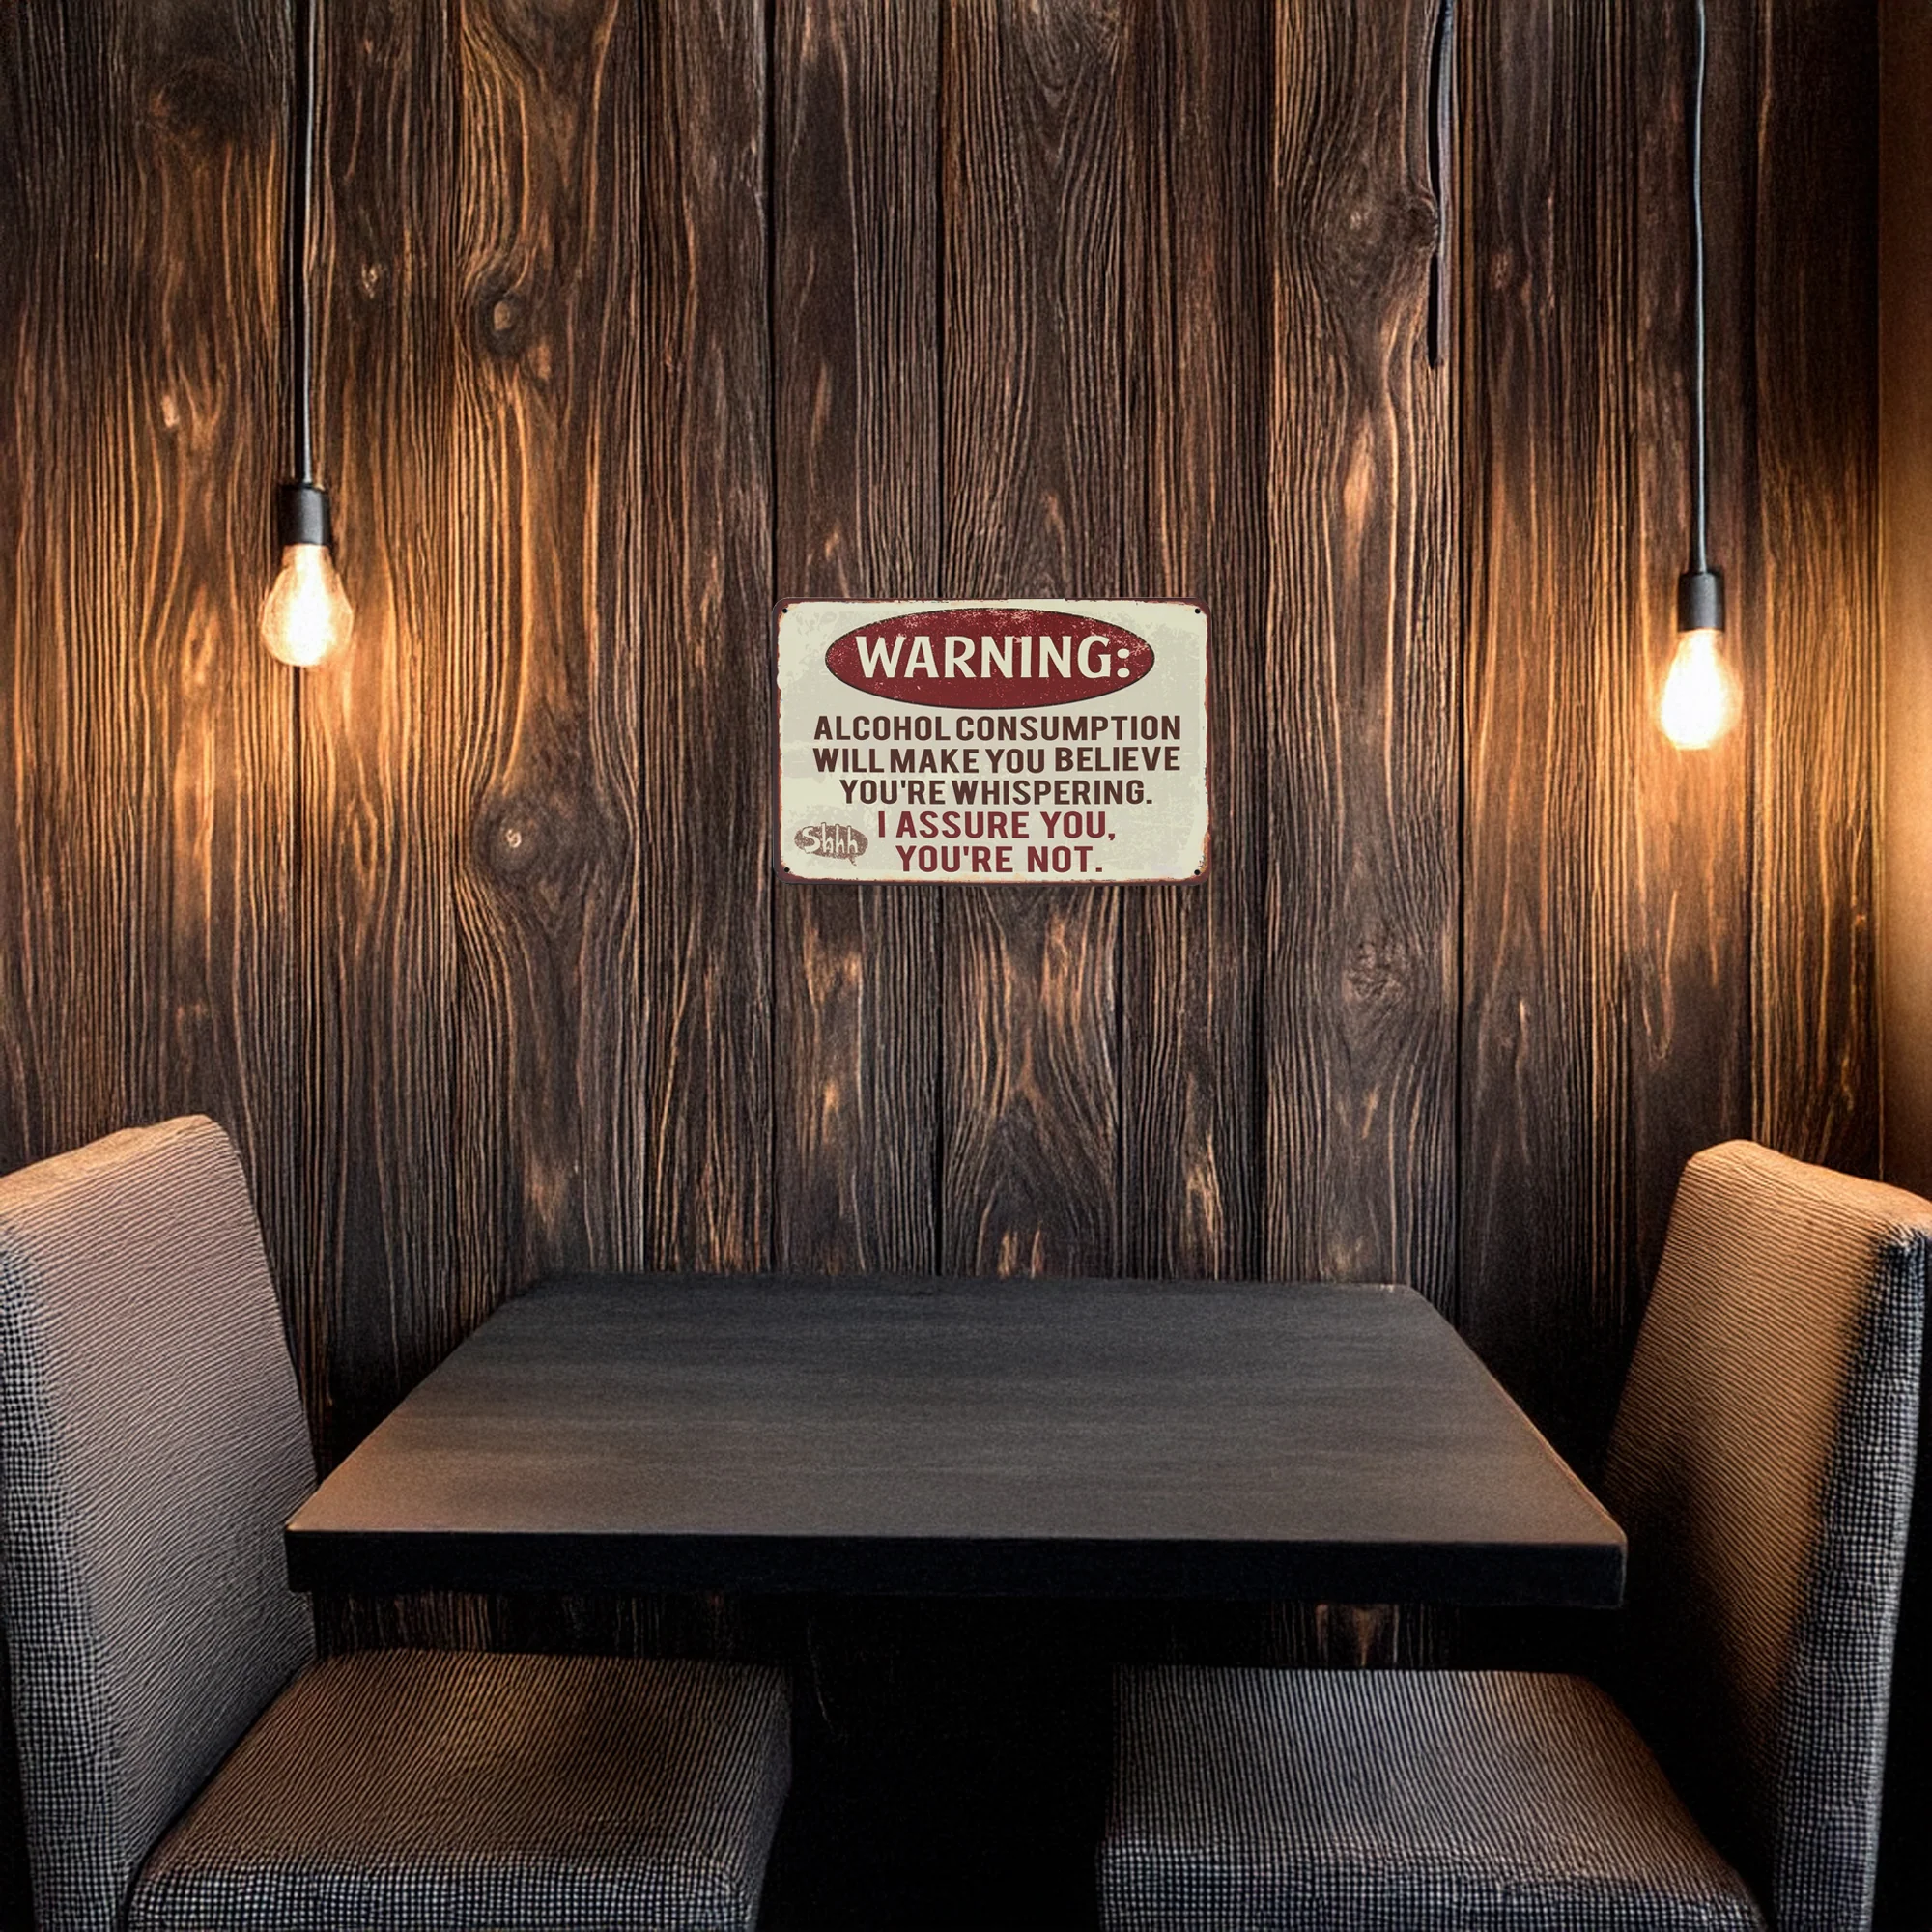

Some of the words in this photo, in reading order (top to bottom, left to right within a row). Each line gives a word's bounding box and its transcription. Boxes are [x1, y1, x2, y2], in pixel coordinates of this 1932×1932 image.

[855, 635, 1131, 678] WARNING:
[813, 715, 952, 741] ALCOHOL
[955, 715, 1181, 741] CONSUMPTION
[812, 748, 885, 773] WILL
[890, 748, 980, 773] MAKE
[985, 748, 1045, 773] YOU
[1054, 746, 1181, 772] BELIEVE
[838, 779, 946, 805] YOU'RE
[952, 779, 1153, 805] WHISPERING.
[802, 822, 859, 854] Shhh
[877, 810, 886, 838] I
[895, 810, 1030, 839] ASSURE
[1040, 810, 1116, 841] YOU,
[895, 845, 1012, 873] YOU'RE
[1027, 845, 1103, 873] NOT.
